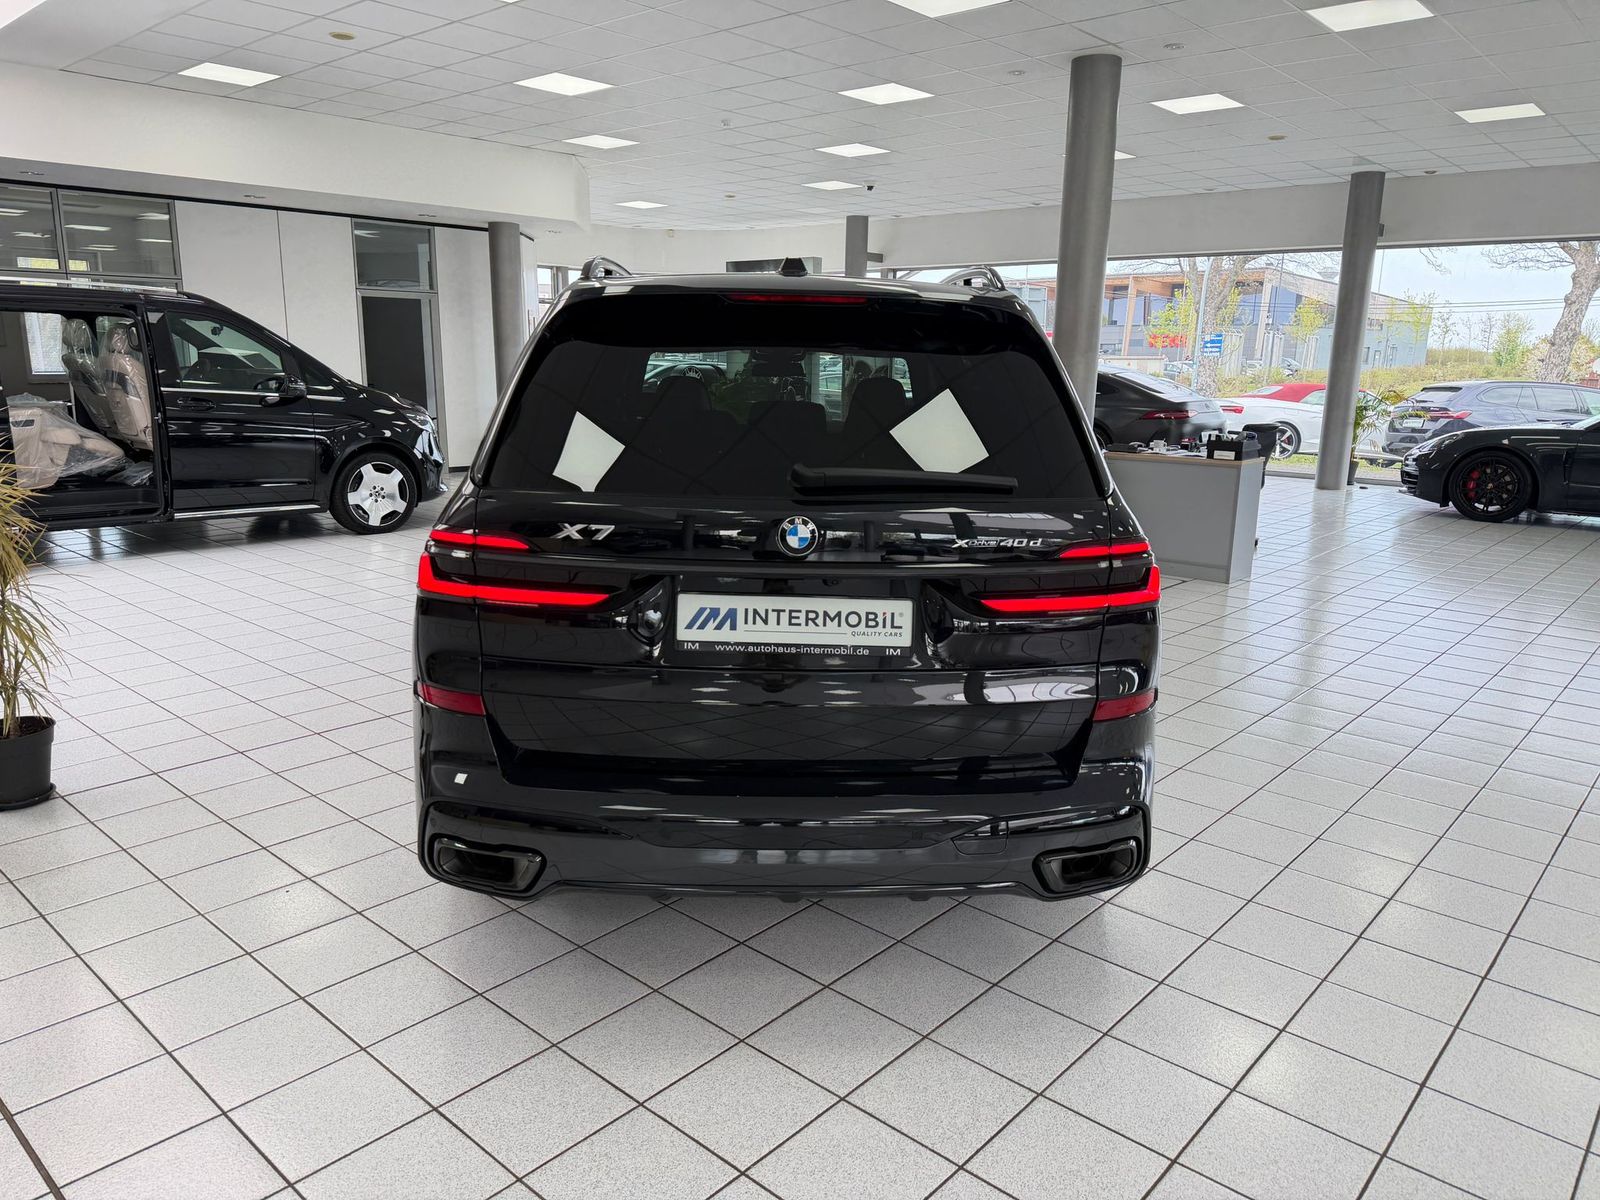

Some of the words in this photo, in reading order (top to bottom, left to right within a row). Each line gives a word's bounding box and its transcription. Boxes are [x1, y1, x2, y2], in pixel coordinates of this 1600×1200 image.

[549, 523, 615, 540] X7
[684, 642, 699, 650] IM
[714, 644, 869, 656] www.autohaus-intermobil.de
[886, 648, 901, 656] IM
